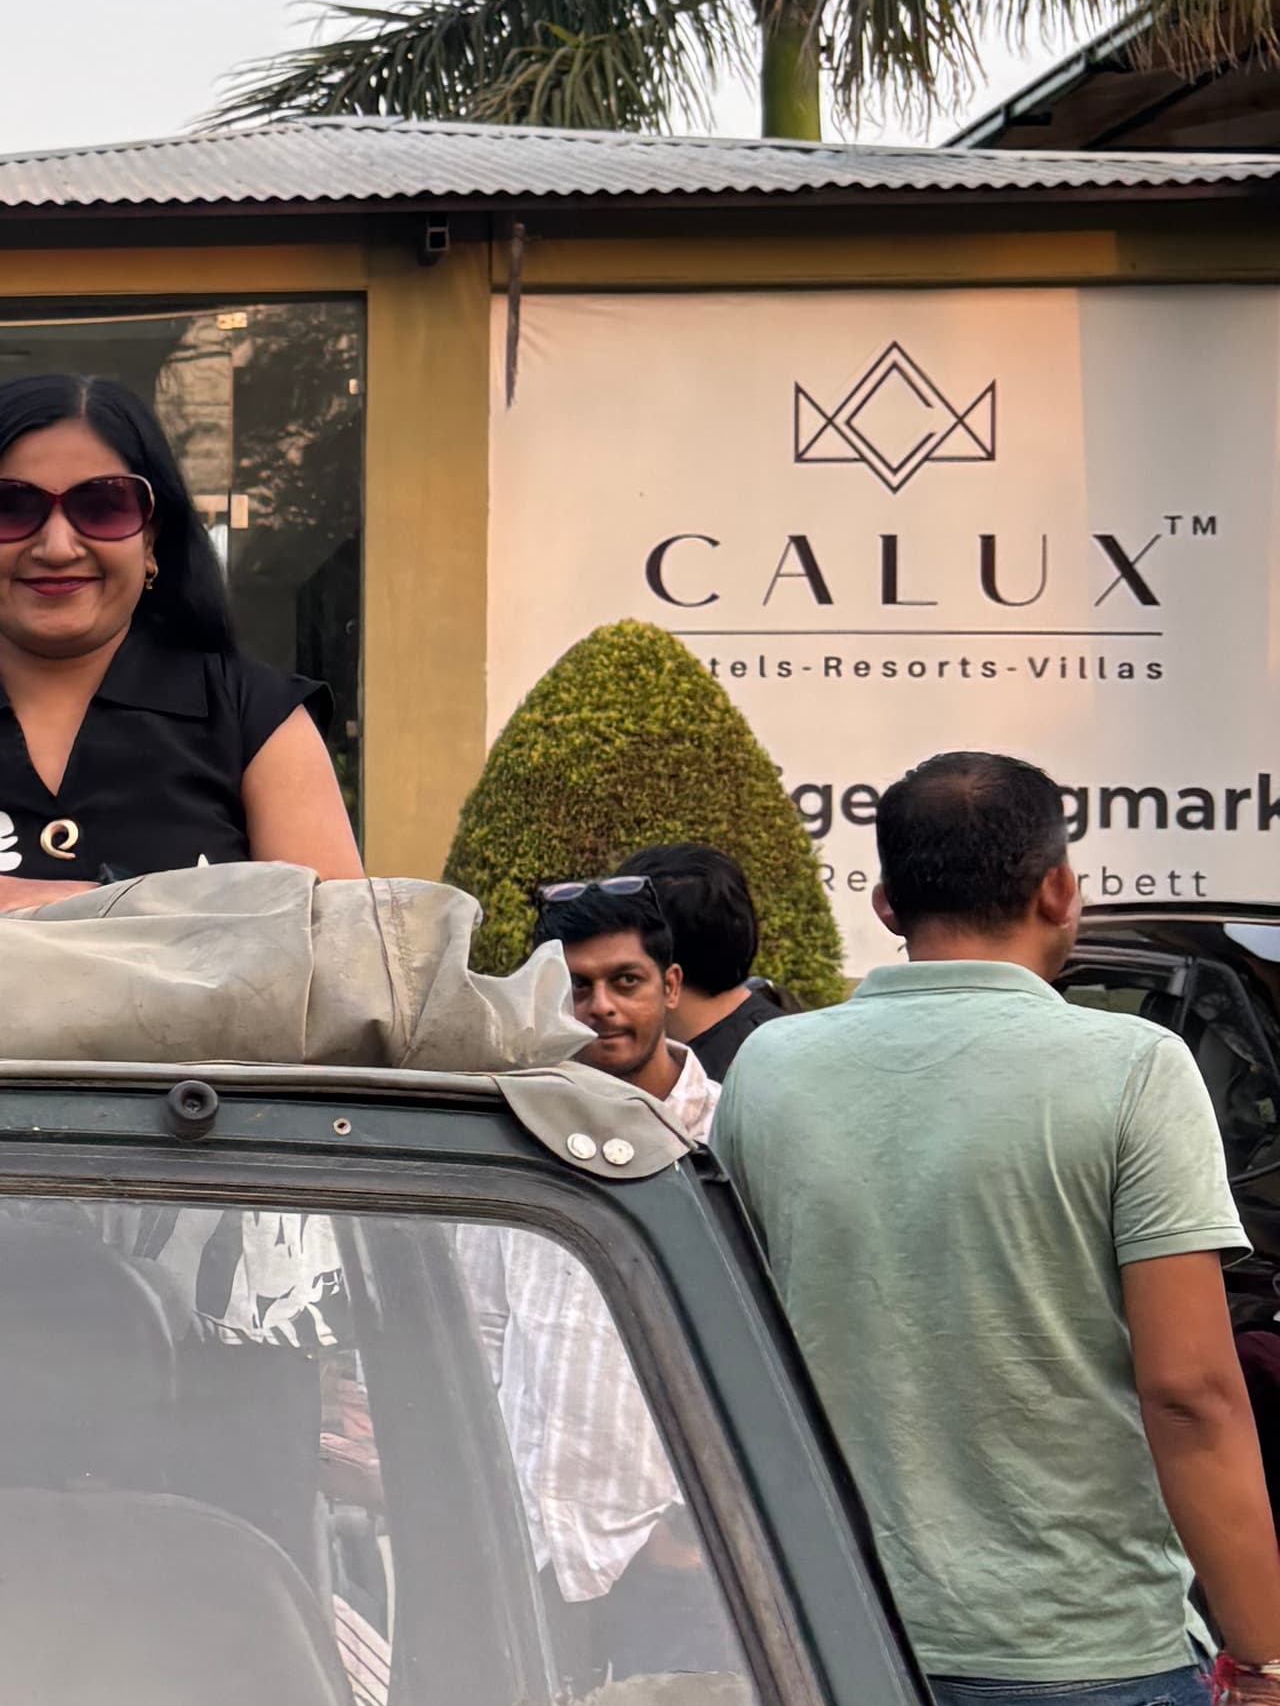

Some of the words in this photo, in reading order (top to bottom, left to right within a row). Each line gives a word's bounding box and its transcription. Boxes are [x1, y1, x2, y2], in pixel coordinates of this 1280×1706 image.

[645, 533, 1161, 608] CALUX
[1163, 514, 1218, 537] TM
[708, 655, 1164, 680] tels-Resorts-Villas
[1057, 773, 1280, 843] gmark
[1077, 865, 1208, 897] rbett
